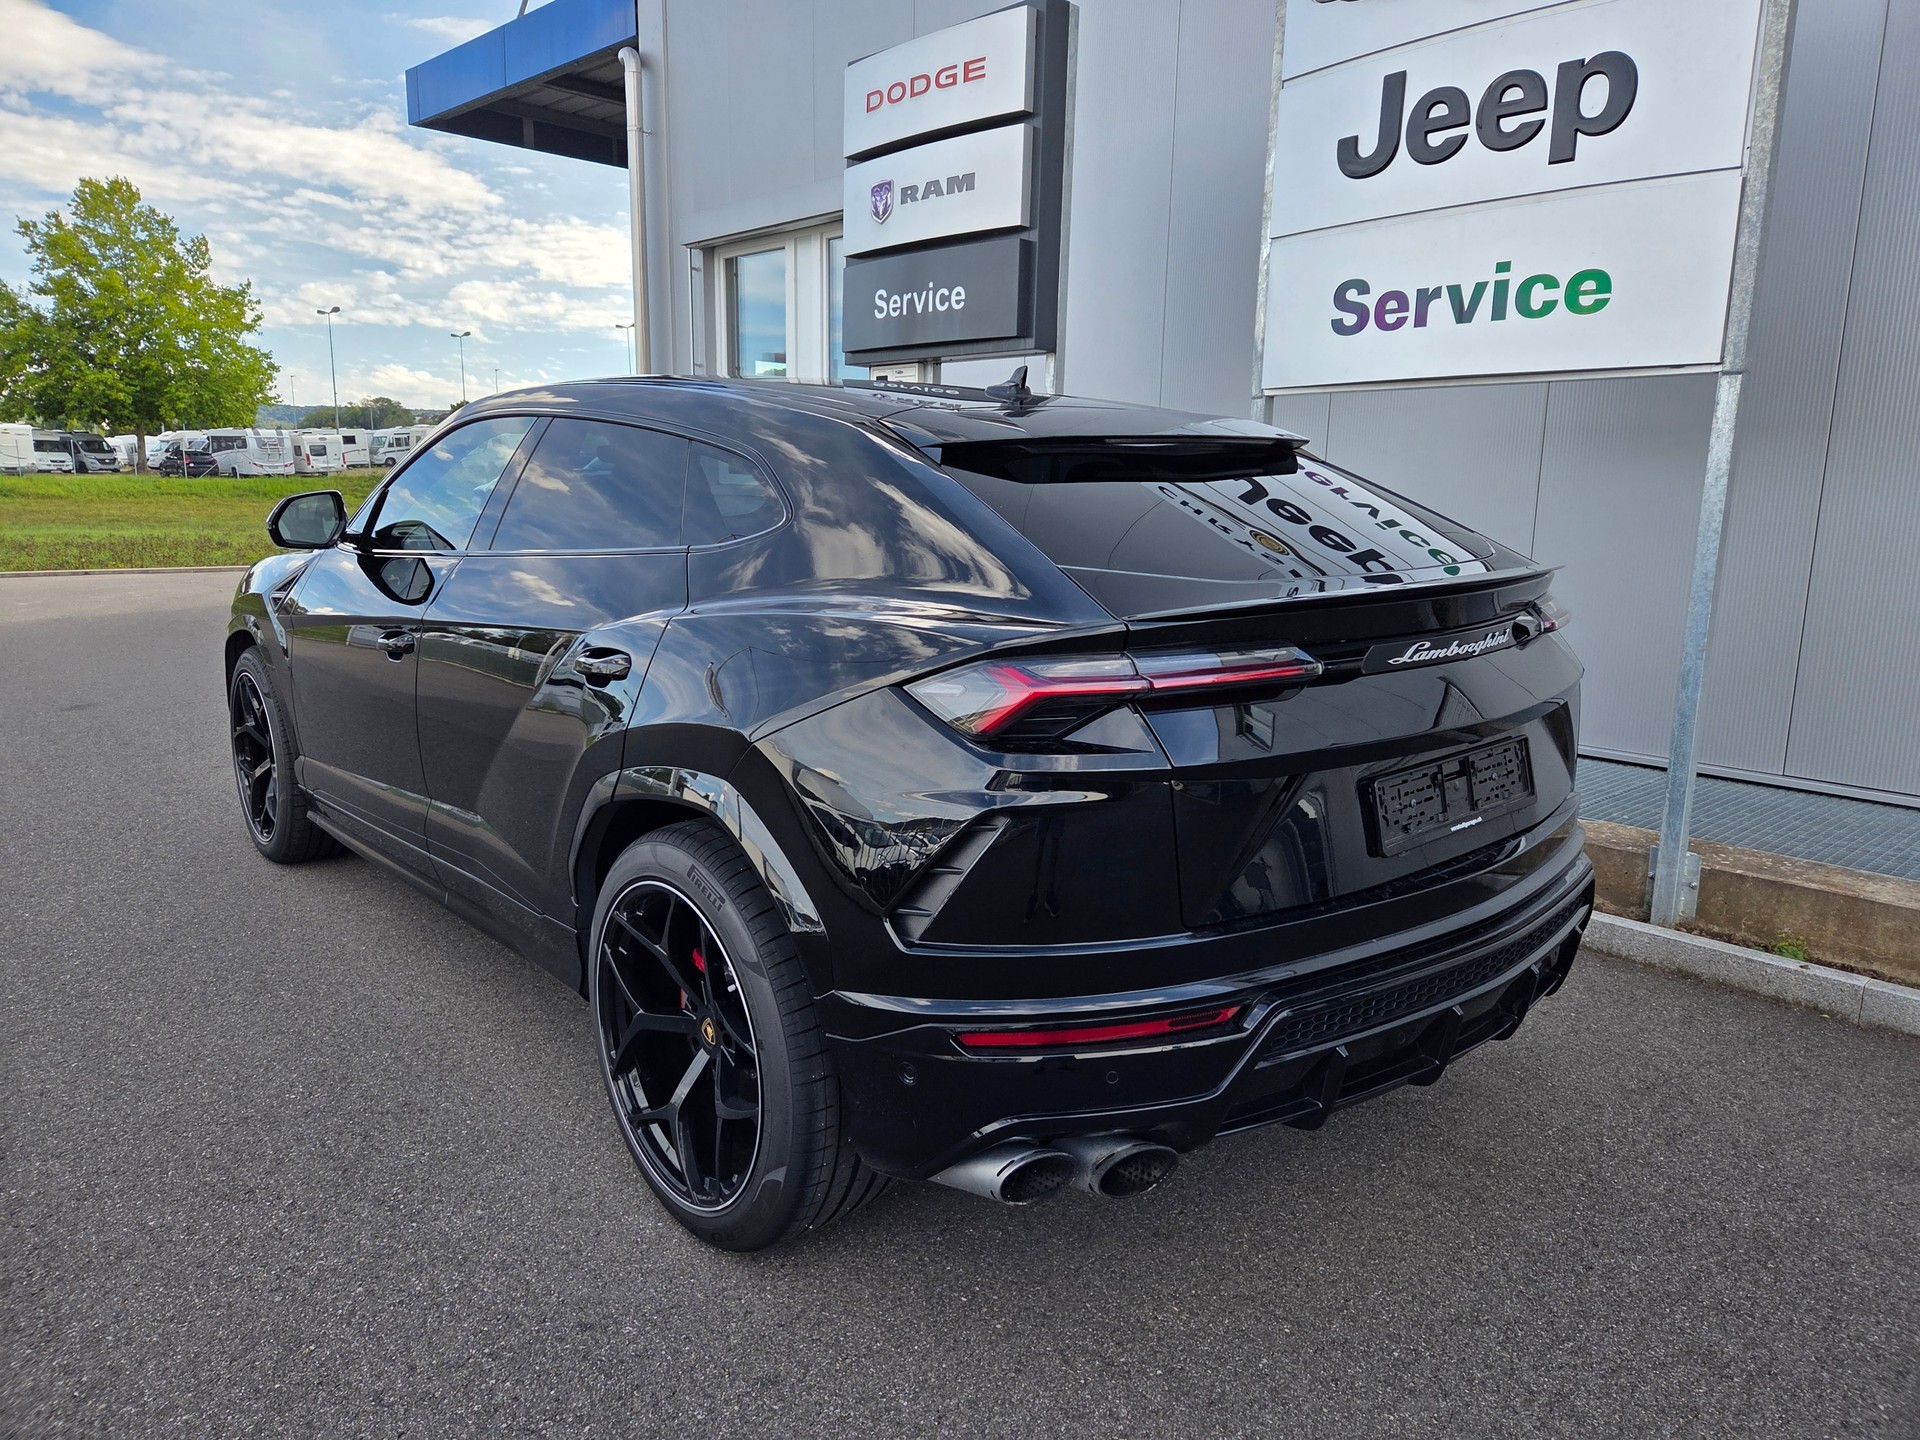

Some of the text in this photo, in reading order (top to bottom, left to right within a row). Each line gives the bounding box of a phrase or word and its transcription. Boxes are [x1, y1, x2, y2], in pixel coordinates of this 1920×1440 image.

[866, 56, 987, 114] DODGE
[1336, 50, 1639, 180] Jeep
[900, 172, 976, 205] RAM
[874, 282, 966, 319] Service
[1331, 260, 1613, 337] Service
[1387, 628, 1510, 665] Lamborghini
[687, 863, 726, 912] PIRELLI
